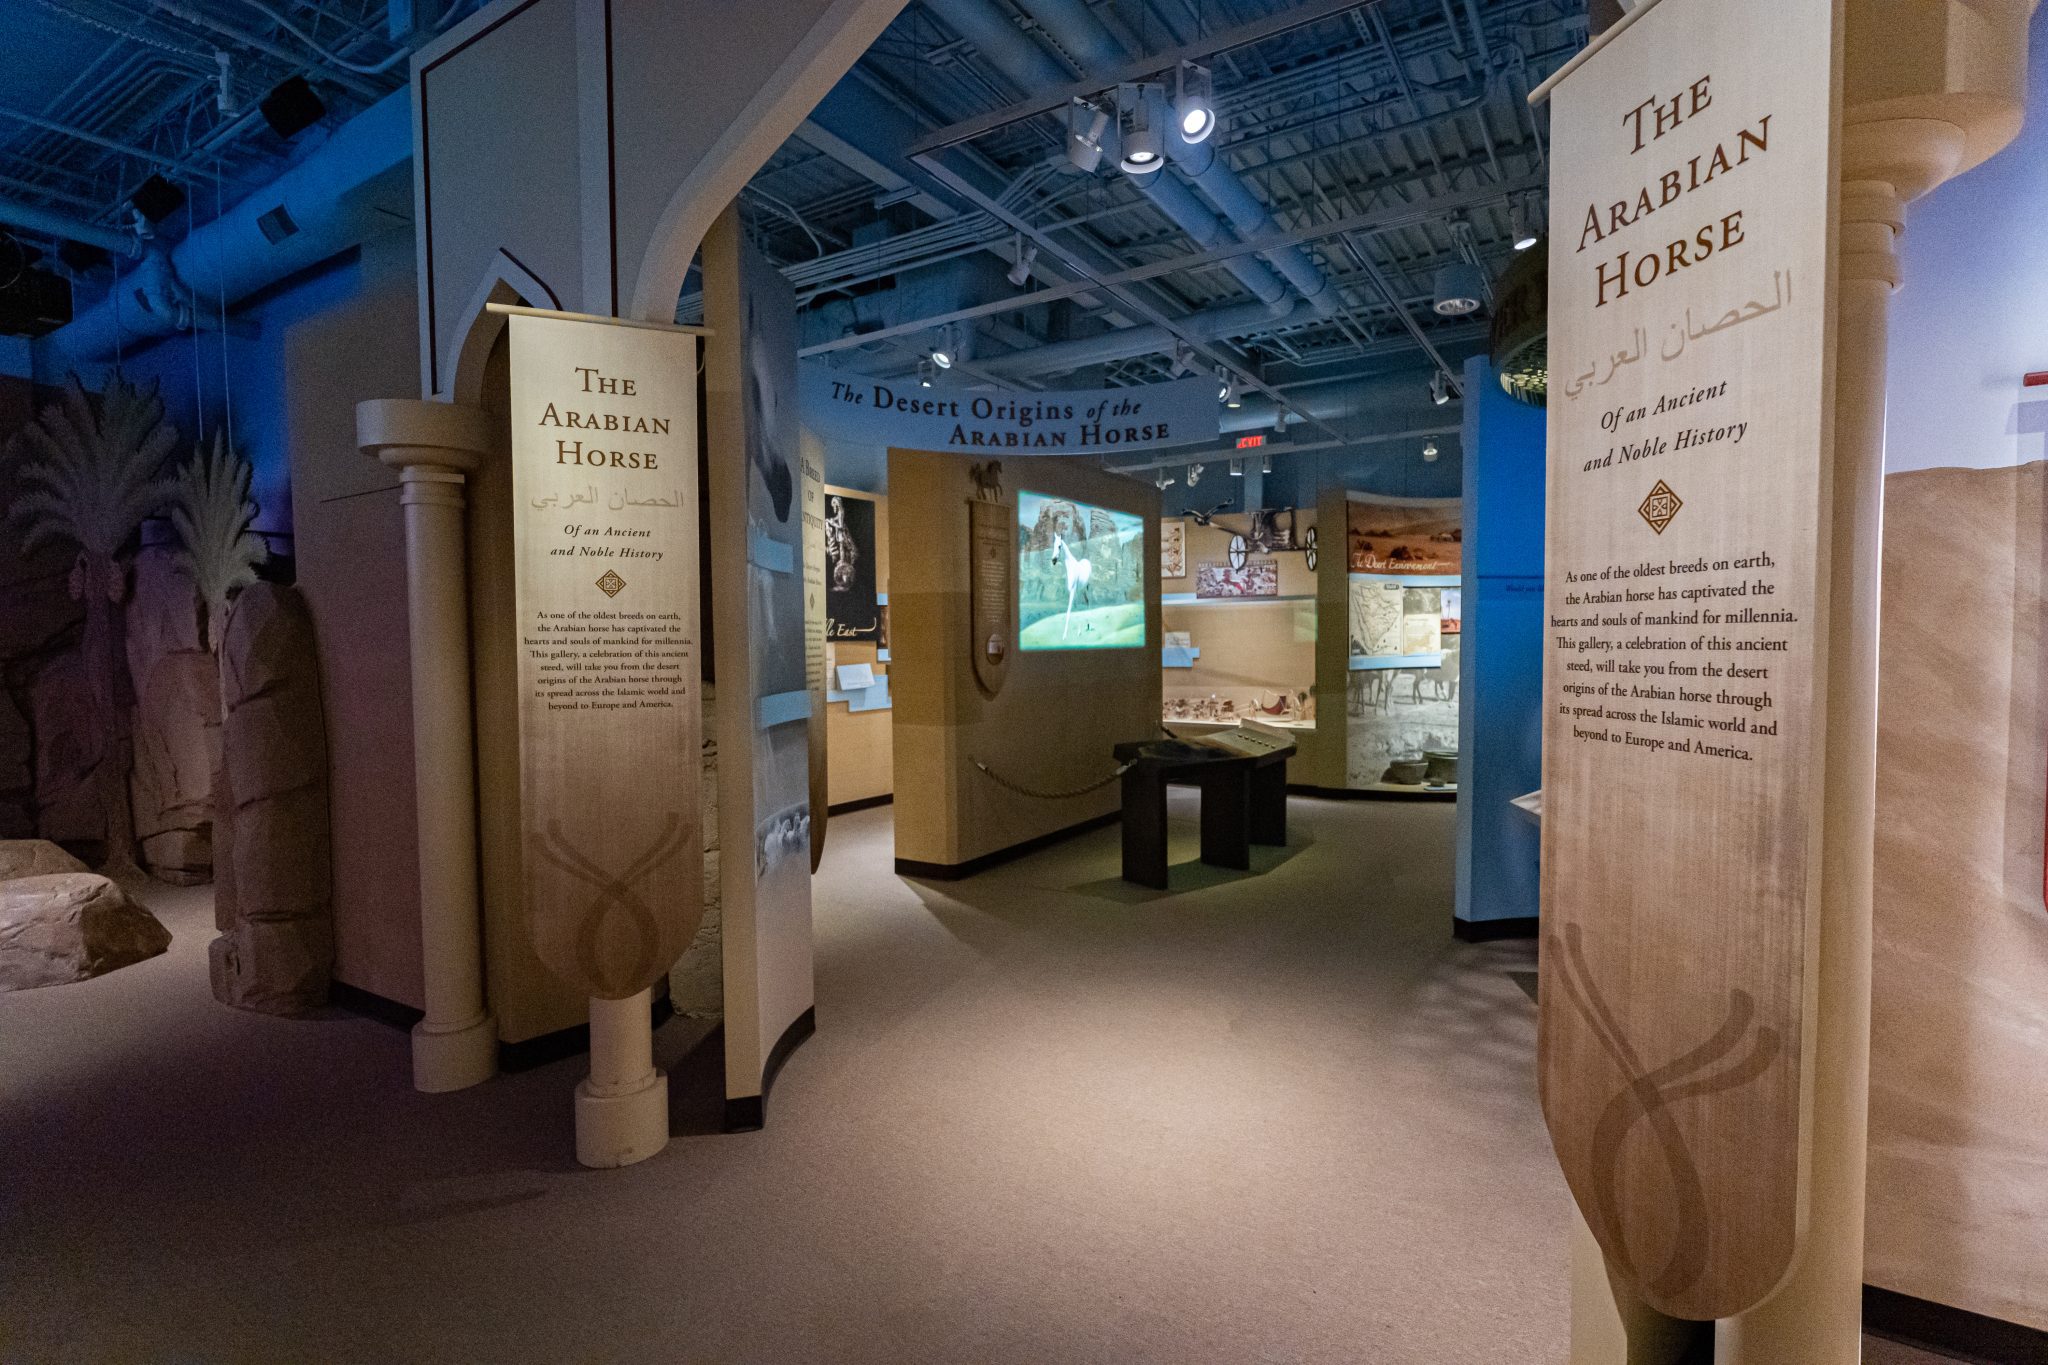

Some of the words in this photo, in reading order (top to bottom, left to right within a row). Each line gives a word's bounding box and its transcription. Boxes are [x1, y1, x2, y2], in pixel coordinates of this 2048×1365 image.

[1622, 74, 1713, 155] THE
[1576, 114, 1772, 253] ARABIAN
[1595, 210, 1745, 307] HORSE
[1660, 268, 1793, 361] الحصان
[1565, 327, 1648, 401] العربي
[575, 367, 636, 396] THE
[832, 381, 863, 404] The
[873, 385, 959, 417] Desert
[971, 397, 1073, 428] Origins
[1086, 399, 1109, 424] of
[1112, 398, 1141, 416] the
[1601, 406, 1625, 433] Of
[1625, 407, 1646, 423] an
[1652, 380, 1728, 415] Ancient
[538, 402, 670, 435] ARABIAN
[949, 422, 1066, 447] ARABIAN
[1080, 423, 1170, 446] HORSE
[1236, 435, 1263, 449] EXIT
[1583, 448, 1612, 472] and
[1618, 436, 1667, 464] Noble
[1673, 421, 1748, 451] History
[556, 440, 658, 470] HORSE
[531, 484, 598, 512] العربي
[608, 487, 683, 511] الحصان
[564, 525, 582, 538] Of
[604, 526, 650, 537] Ancient
[550, 546, 575, 556] and
[579, 546, 614, 557] Noble
[619, 548, 663, 561] History
[1565, 571, 1578, 583] As
[1580, 572, 1597, 582] one
[1600, 566, 1612, 580] of
[1613, 565, 1630, 579] the
[1633, 562, 1665, 577] oldest
[1669, 557, 1708, 574] breeds
[1712, 561, 1729, 571] on
[1733, 551, 1775, 569] earth,
[1565, 592, 1580, 605] the
[1583, 590, 1622, 604] Arabian
[1625, 588, 1655, 602] horse
[1658, 586, 1677, 600] has
[1681, 580, 1747, 603] captivated
[1752, 580, 1775, 595] the
[537, 611, 548, 619] As
[567, 611, 576, 619] of
[578, 611, 591, 619] the
[593, 611, 616, 619] oldest
[618, 611, 644, 620] breeds
[658, 612, 681, 620] earth,
[1551, 615, 1578, 627] hearts
[1581, 613, 1599, 627] and
[1602, 612, 1627, 626] souls
[1630, 611, 1643, 626] of
[1645, 610, 1698, 625] mankind
[1703, 609, 1721, 624] for
[1725, 608, 1798, 624] millennia.
[524, 637, 550, 645] hearts
[552, 637, 567, 645] and
[570, 637, 590, 645] souls
[592, 637, 601, 645] of
[603, 637, 639, 645] mankind
[641, 637, 653, 645] for
[654, 637, 693, 645] millennia.
[537, 624, 551, 632] the
[553, 624, 586, 632] Arabian
[588, 624, 609, 632] horse
[611, 624, 625, 632] has
[627, 625, 667, 634] captivated
[669, 624, 681, 632] the
[529, 650, 548, 658] This
[551, 650, 580, 660] gallery,
[589, 650, 632, 658] celebration
[645, 649, 660, 657] this
[1556, 636, 1576, 649] This
[1578, 636, 1613, 653] gallery,
[1616, 641, 1623, 650] a
[1625, 636, 1686, 650] celebration
[1690, 635, 1705, 650] of
[1707, 635, 1732, 651] this
[1736, 637, 1788, 651] ancient
[540, 663, 564, 672] steed,
[566, 663, 582, 671] will
[584, 663, 601, 671] take
[620, 662, 640, 670] from
[642, 662, 655, 670] the
[656, 662, 679, 670] desert
[1566, 659, 1593, 673] steed,
[1596, 659, 1615, 672] will
[1618, 660, 1641, 674] take
[1643, 665, 1665, 678] you
[1668, 660, 1697, 676] from
[1702, 662, 1723, 677] the
[1726, 662, 1768, 679] desert
[537, 677, 566, 686] origins
[568, 676, 578, 684] of
[579, 676, 592, 684] the
[594, 675, 626, 683] Arabian
[628, 675, 649, 683] horse
[651, 674, 682, 685] through
[547, 689, 573, 699] spread
[602, 688, 615, 696] the
[617, 688, 645, 696] Islamic
[647, 687, 669, 695] world
[671, 687, 686, 695] and
[548, 701, 578, 711] beyond
[591, 701, 620, 711] Europe
[622, 700, 637, 708] and
[639, 700, 673, 708] America.
[1563, 682, 1595, 698] origins
[1598, 682, 1609, 695] of
[1611, 683, 1628, 697] the
[1630, 685, 1675, 700] Arabian
[1679, 686, 1712, 703] horse
[1716, 689, 1772, 712] through
[1559, 703, 1570, 714] its
[1573, 705, 1603, 720] spread
[1605, 710, 1637, 721] across
[1640, 709, 1658, 723] the
[1661, 711, 1704, 728] Islamic
[1708, 717, 1746, 733] world
[1750, 720, 1777, 736] and
[1573, 725, 1608, 742] beyond
[1611, 732, 1622, 743] to
[1625, 731, 1665, 752] Europe
[1668, 738, 1690, 753] and
[1694, 740, 1753, 761] America.
